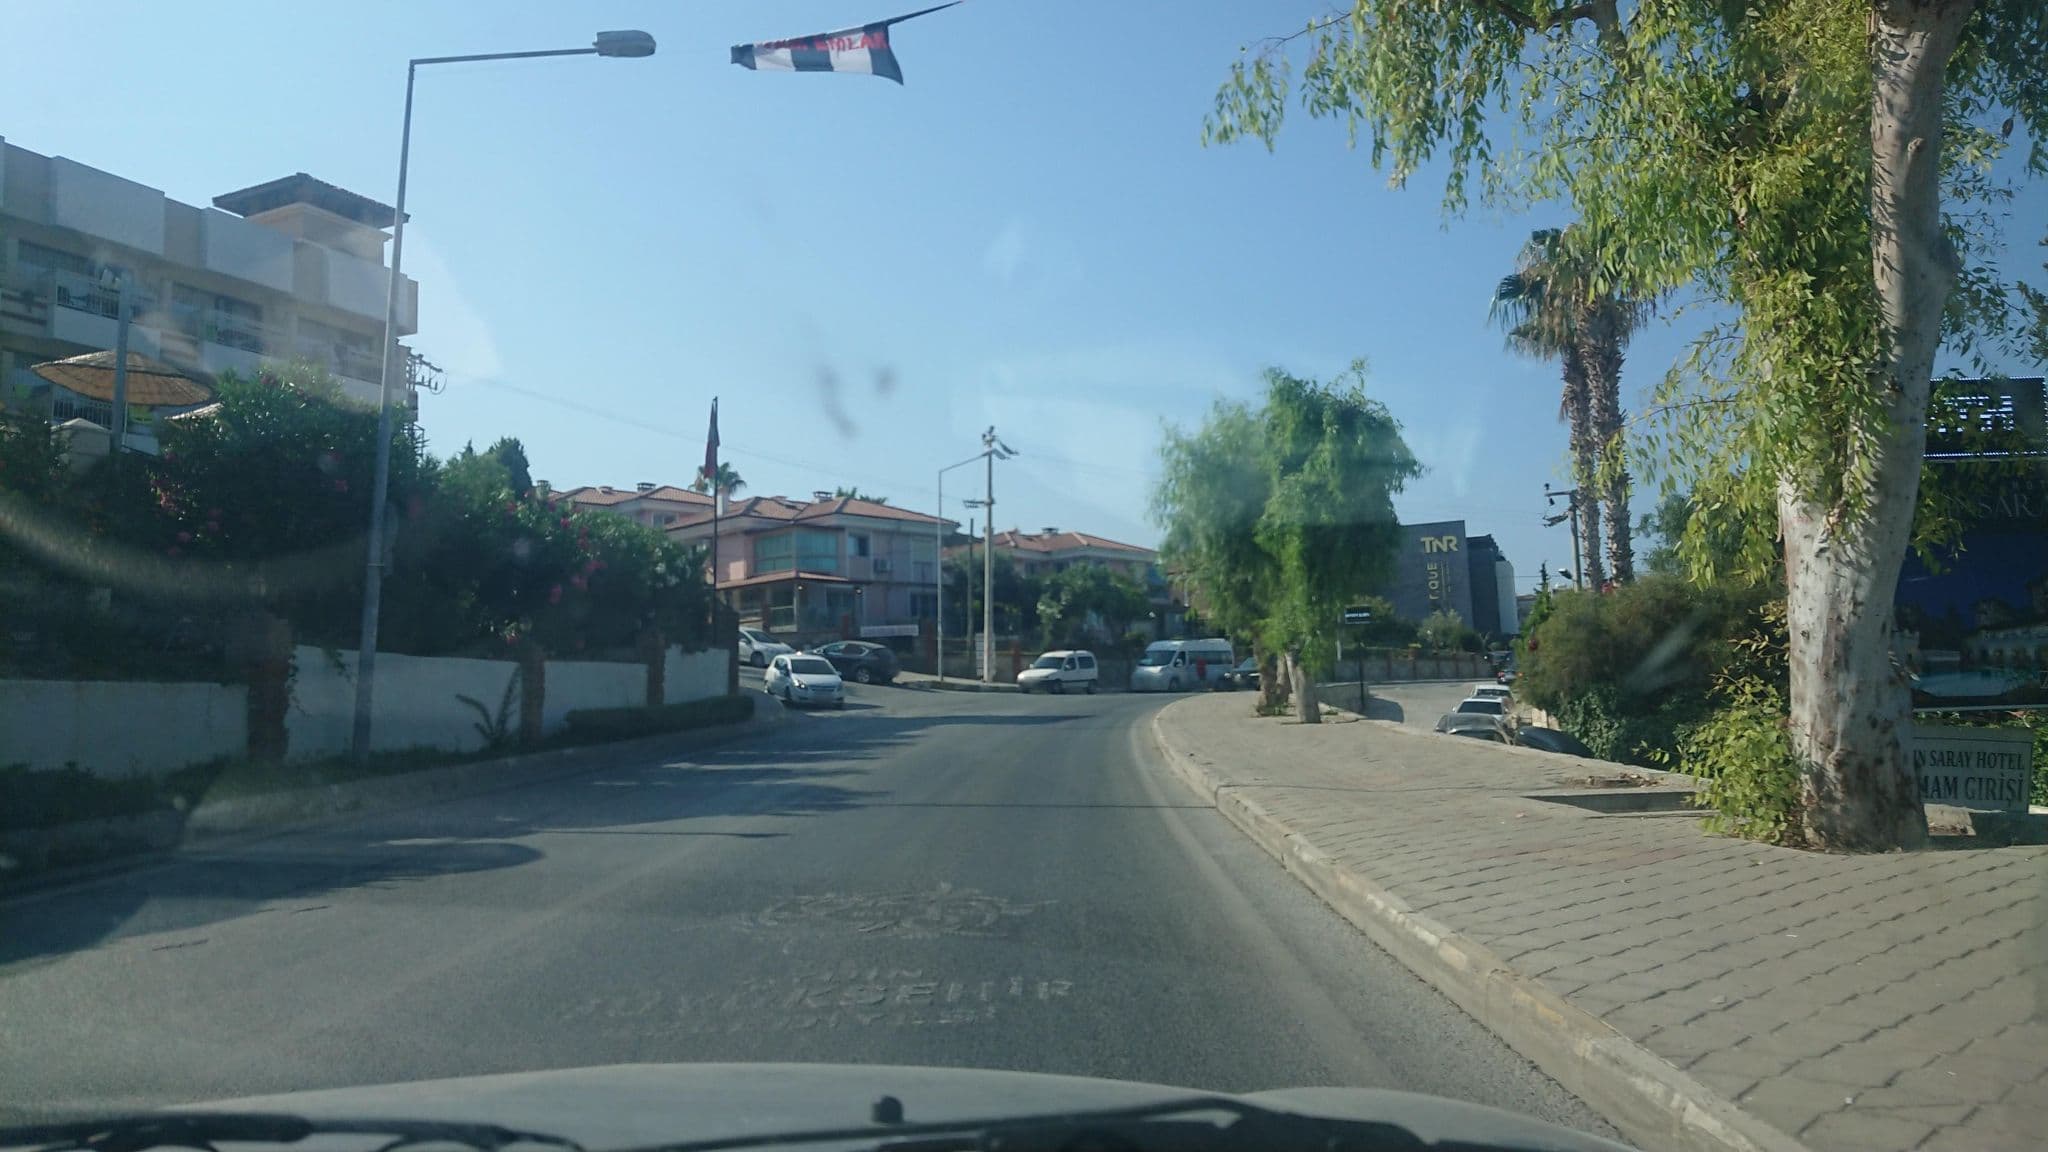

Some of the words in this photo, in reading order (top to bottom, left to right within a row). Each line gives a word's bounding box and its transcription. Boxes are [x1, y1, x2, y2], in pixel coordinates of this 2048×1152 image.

[1420, 536, 1458, 552] TNR
[1929, 750, 1971, 768] SARAY
[1976, 751, 2025, 770] HOTEL
